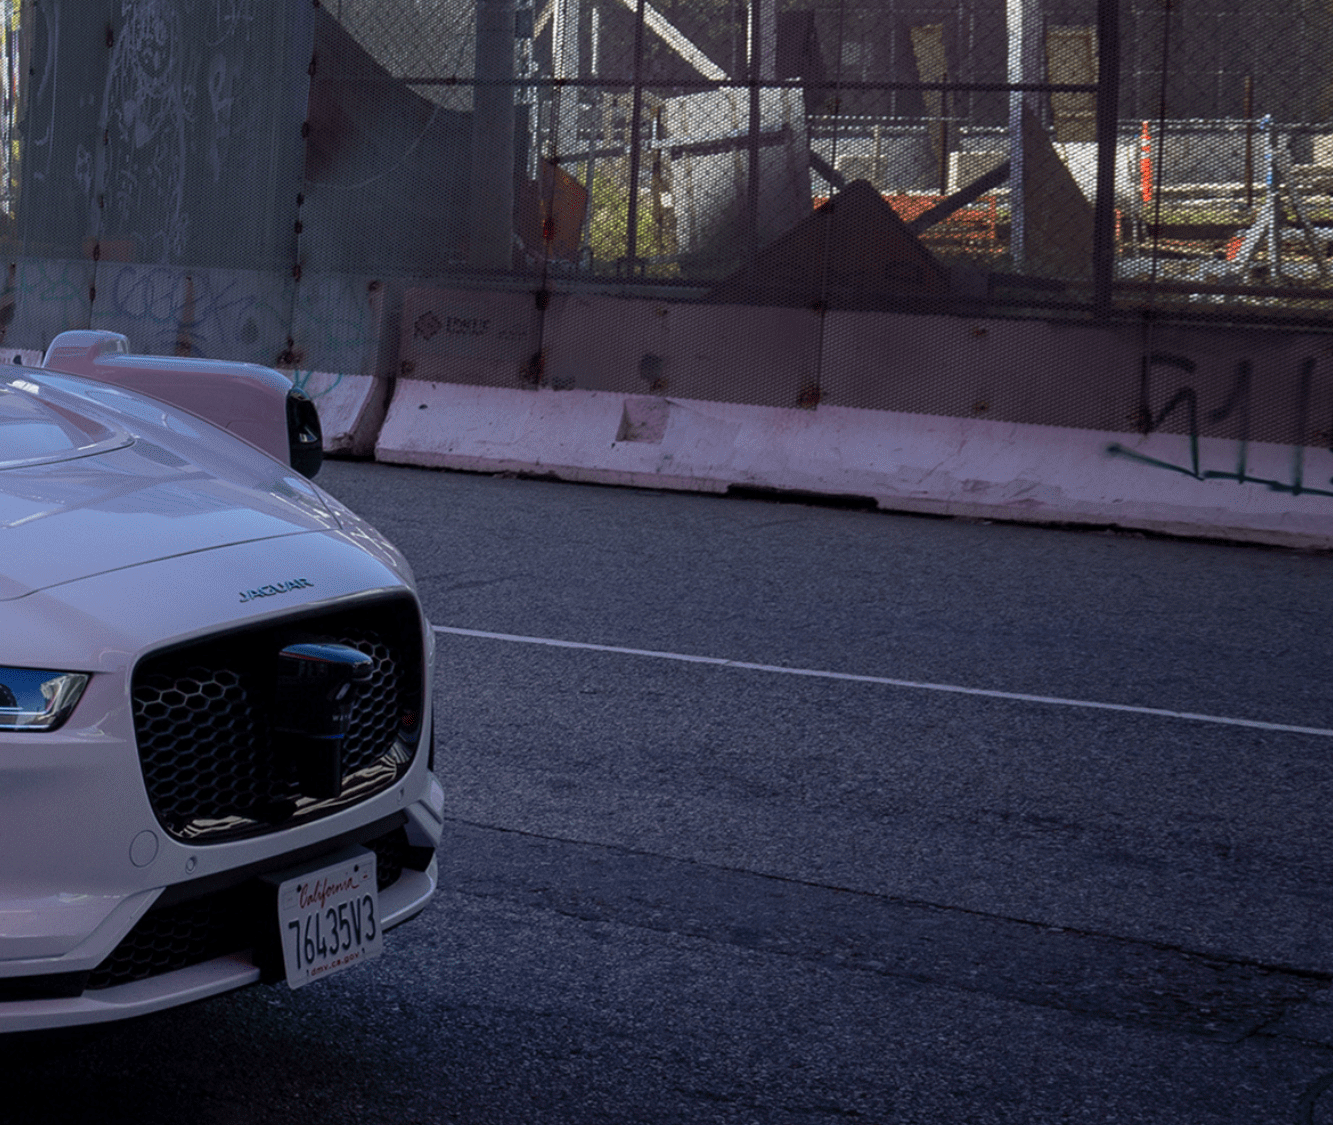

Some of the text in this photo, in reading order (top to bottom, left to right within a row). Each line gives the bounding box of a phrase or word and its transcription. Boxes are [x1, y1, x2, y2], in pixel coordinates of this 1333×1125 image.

[239, 578, 314, 603] JAGUAR
[299, 877, 360, 909] California
[288, 893, 376, 970] 76435V3
[311, 952, 360, 976] dmv.ca.gov
